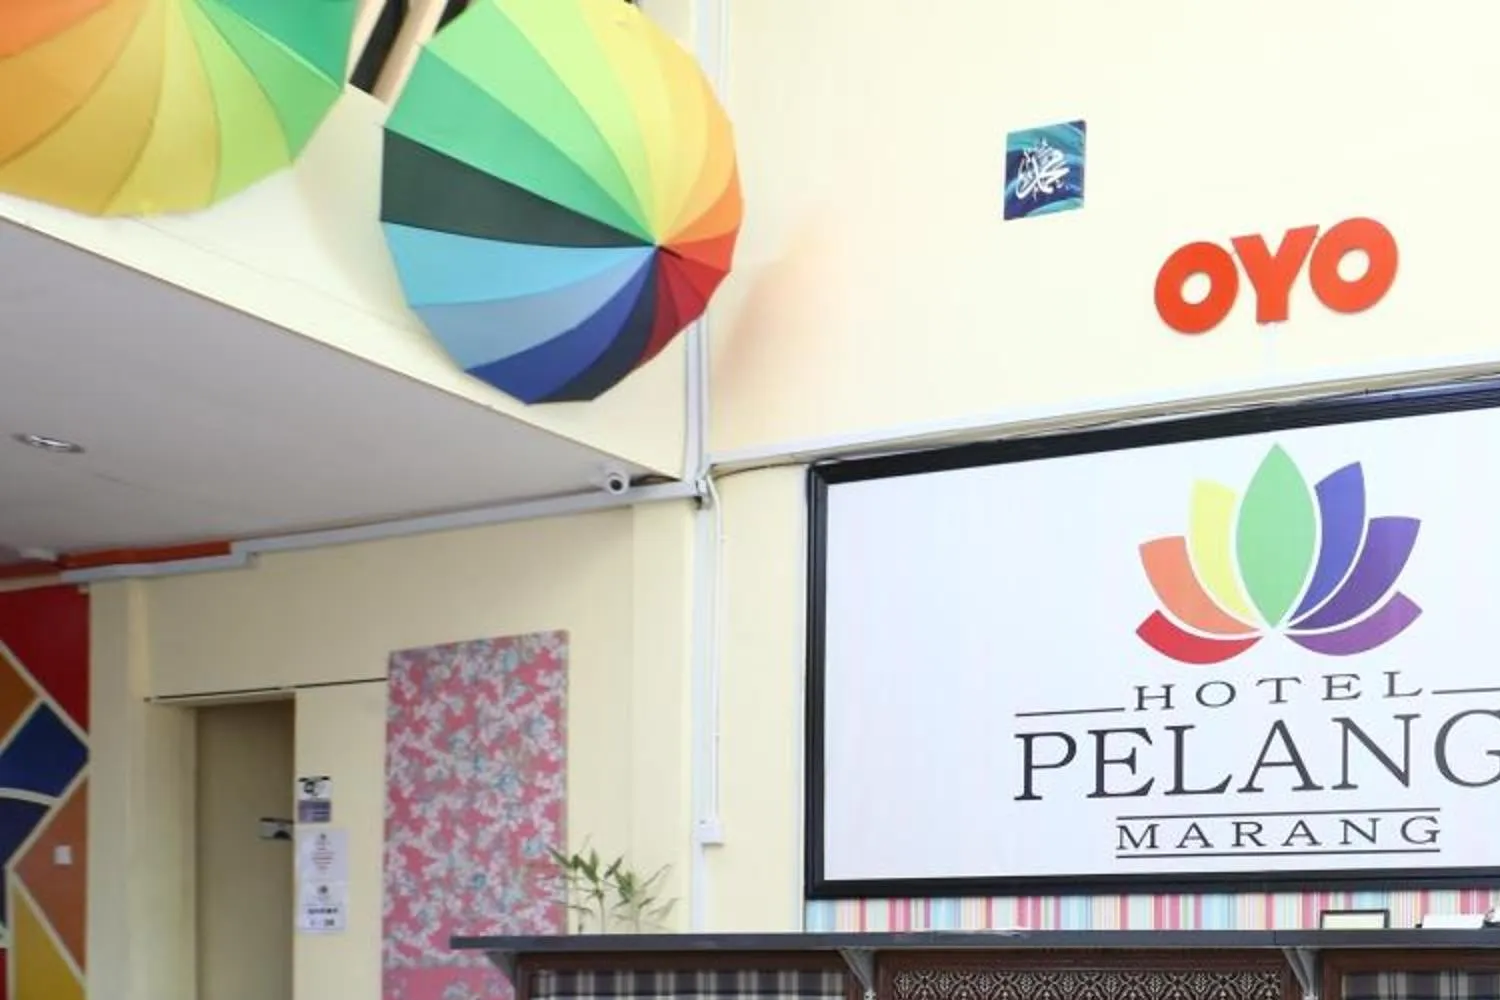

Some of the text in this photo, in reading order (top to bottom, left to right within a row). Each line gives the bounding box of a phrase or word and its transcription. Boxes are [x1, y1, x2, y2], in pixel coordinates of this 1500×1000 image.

[1154, 216, 1399, 334] OYO
[1134, 670, 1424, 711] HOTEL
[1115, 816, 1442, 851] MARANG
